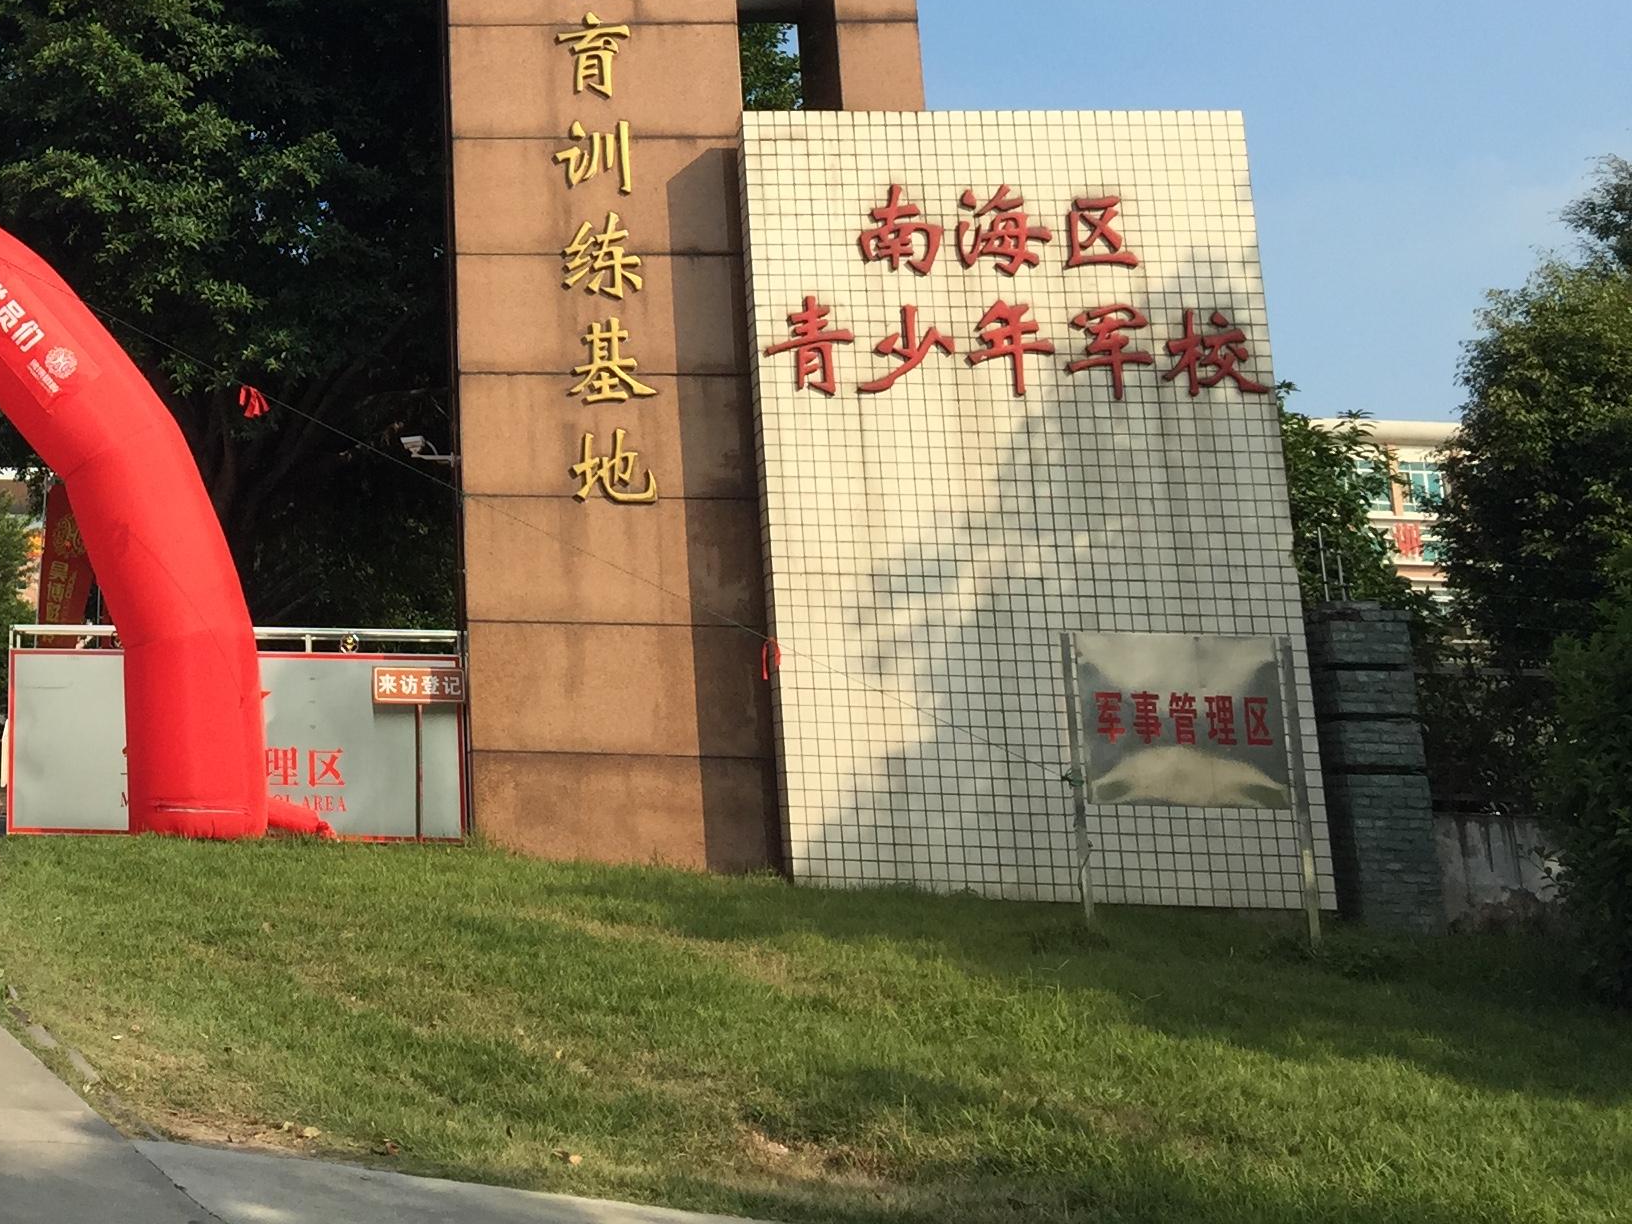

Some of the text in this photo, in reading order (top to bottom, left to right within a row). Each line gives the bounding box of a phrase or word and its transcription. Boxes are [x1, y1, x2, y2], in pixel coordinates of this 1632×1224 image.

[857, 183, 1139, 277] 南海区
[764, 295, 1270, 401] 青少年军校
[378, 674, 461, 695] 来访登记
[1093, 690, 1275, 747] 军事管理区
